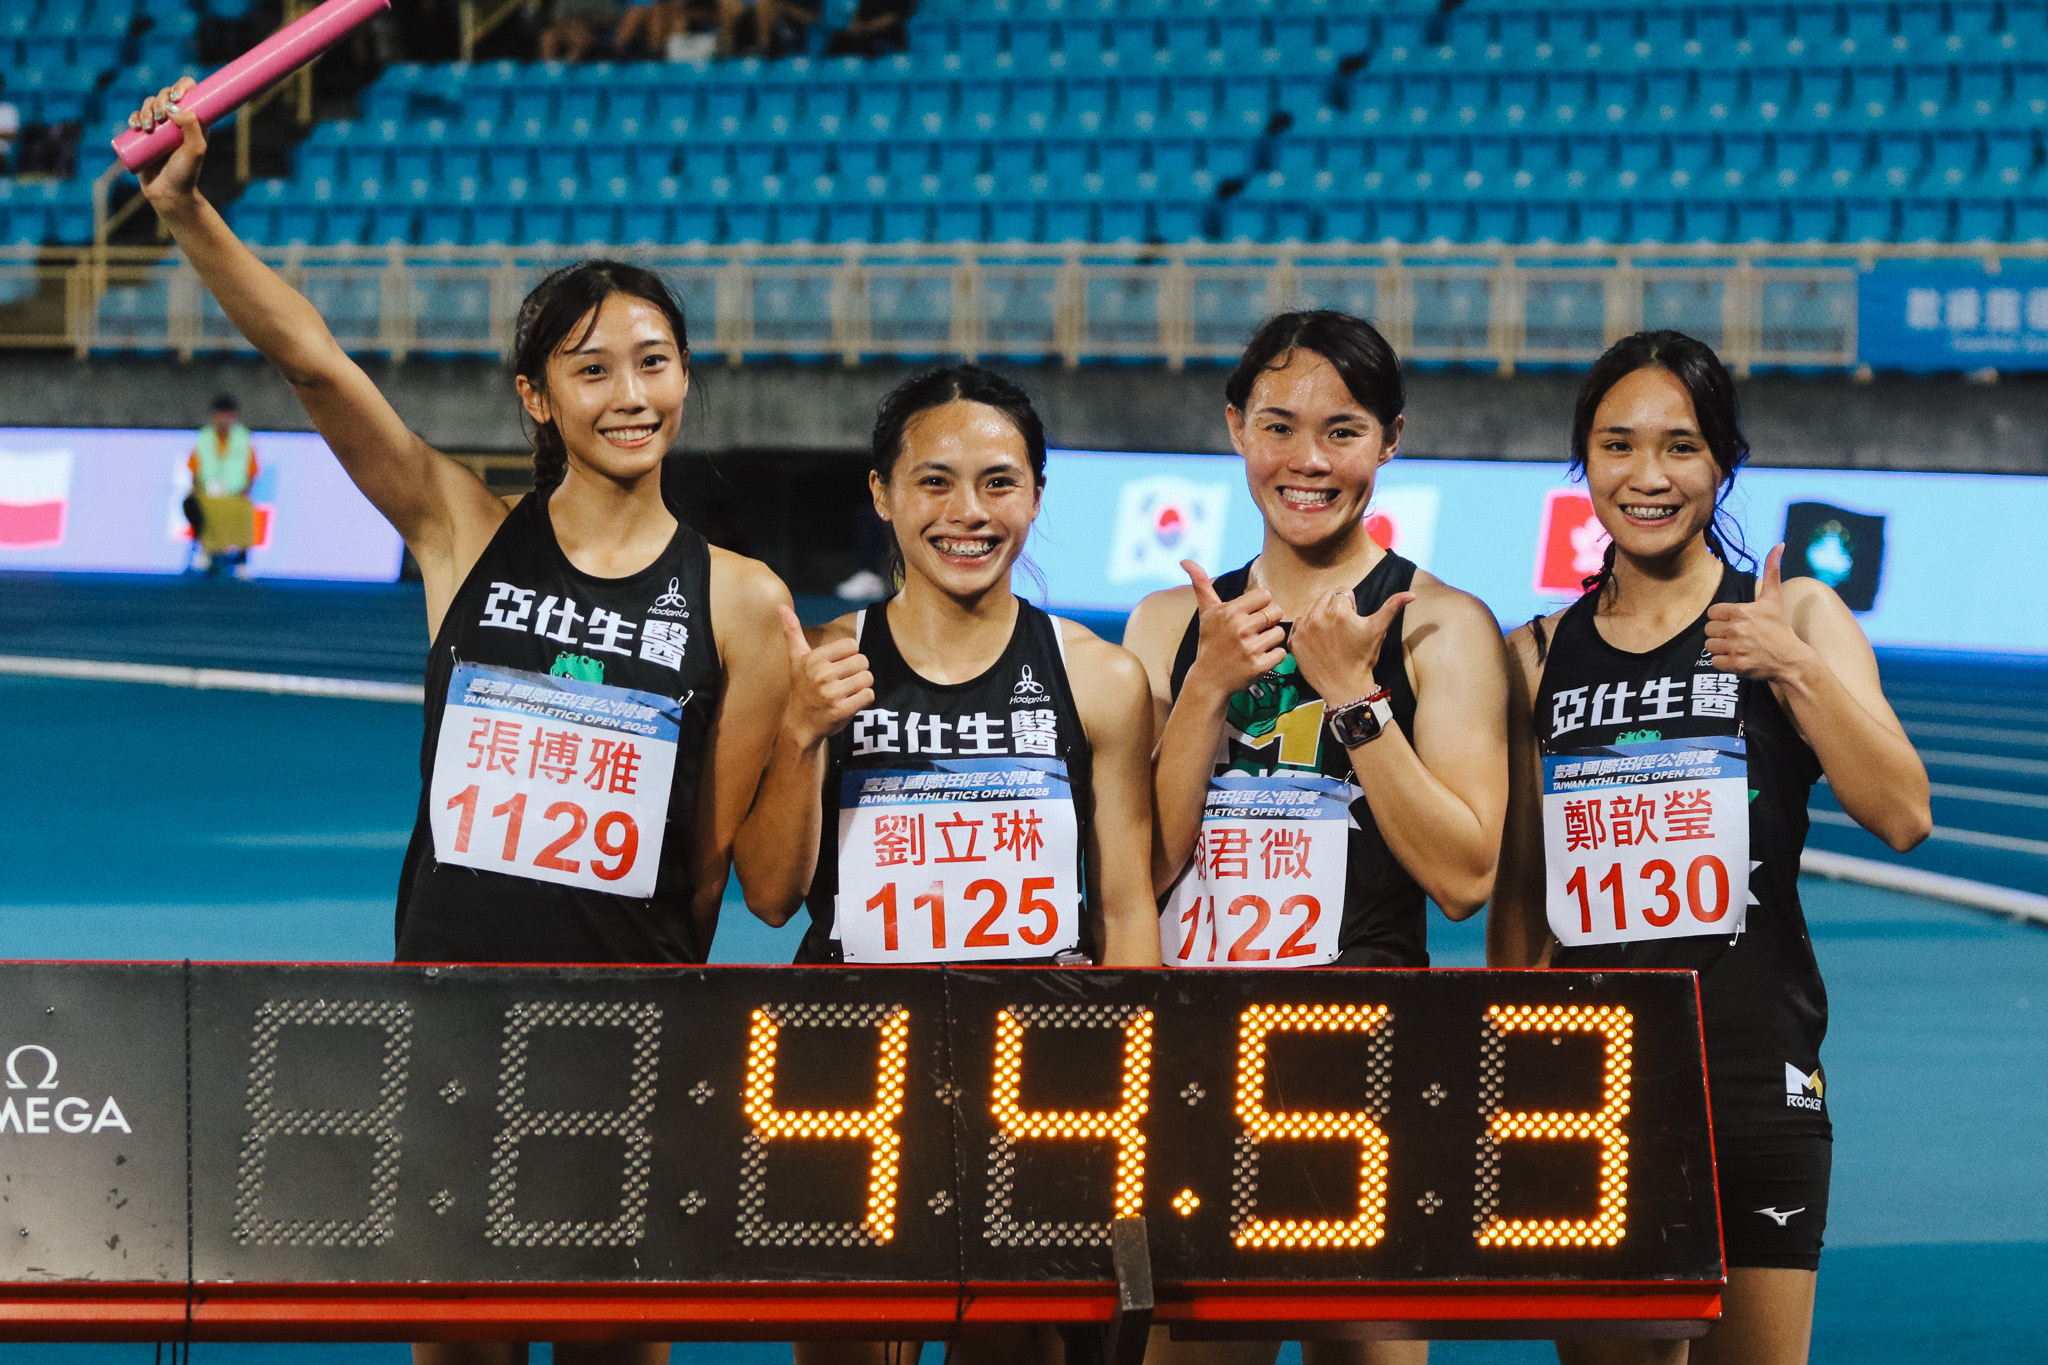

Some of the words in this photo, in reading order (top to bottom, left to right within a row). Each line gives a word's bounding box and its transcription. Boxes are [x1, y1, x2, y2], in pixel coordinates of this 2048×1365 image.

[479, 581, 689, 672] 亞仕生醫
[463, 693, 511, 711] TAIWAN
[511, 701, 581, 722] ATHLETICS
[583, 712, 620, 729] OPEN
[620, 720, 658, 735] 2025
[852, 708, 1058, 756] 亞仕生醫
[1551, 672, 1740, 740] 亞仕生醫
[466, 717, 642, 795] 張博雅
[1553, 779, 1587, 791] TAIWAN
[1587, 773, 1649, 788] ATHLETICS
[1652, 768, 1686, 781] OPEN
[1686, 766, 1721, 777] 2025
[858, 792, 909, 805] TAIWAN
[910, 789, 978, 803] ATHLETICS
[981, 788, 1016, 800] OPEN
[1017, 787, 1050, 798] 2025
[1250, 807, 1286, 817] OPEN
[1286, 807, 1322, 818] 2025
[1563, 788, 1715, 852] 鄭歆瑩
[446, 784, 639, 881] 1129
[873, 808, 1044, 867] 劉立琳
[866, 876, 1058, 951] 1125
[1566, 854, 1729, 933] 1130
[1177, 894, 1321, 962] 1122
[0, 1095, 132, 1134] MEGA
[744, 1004, 1634, 1246] 44.53
